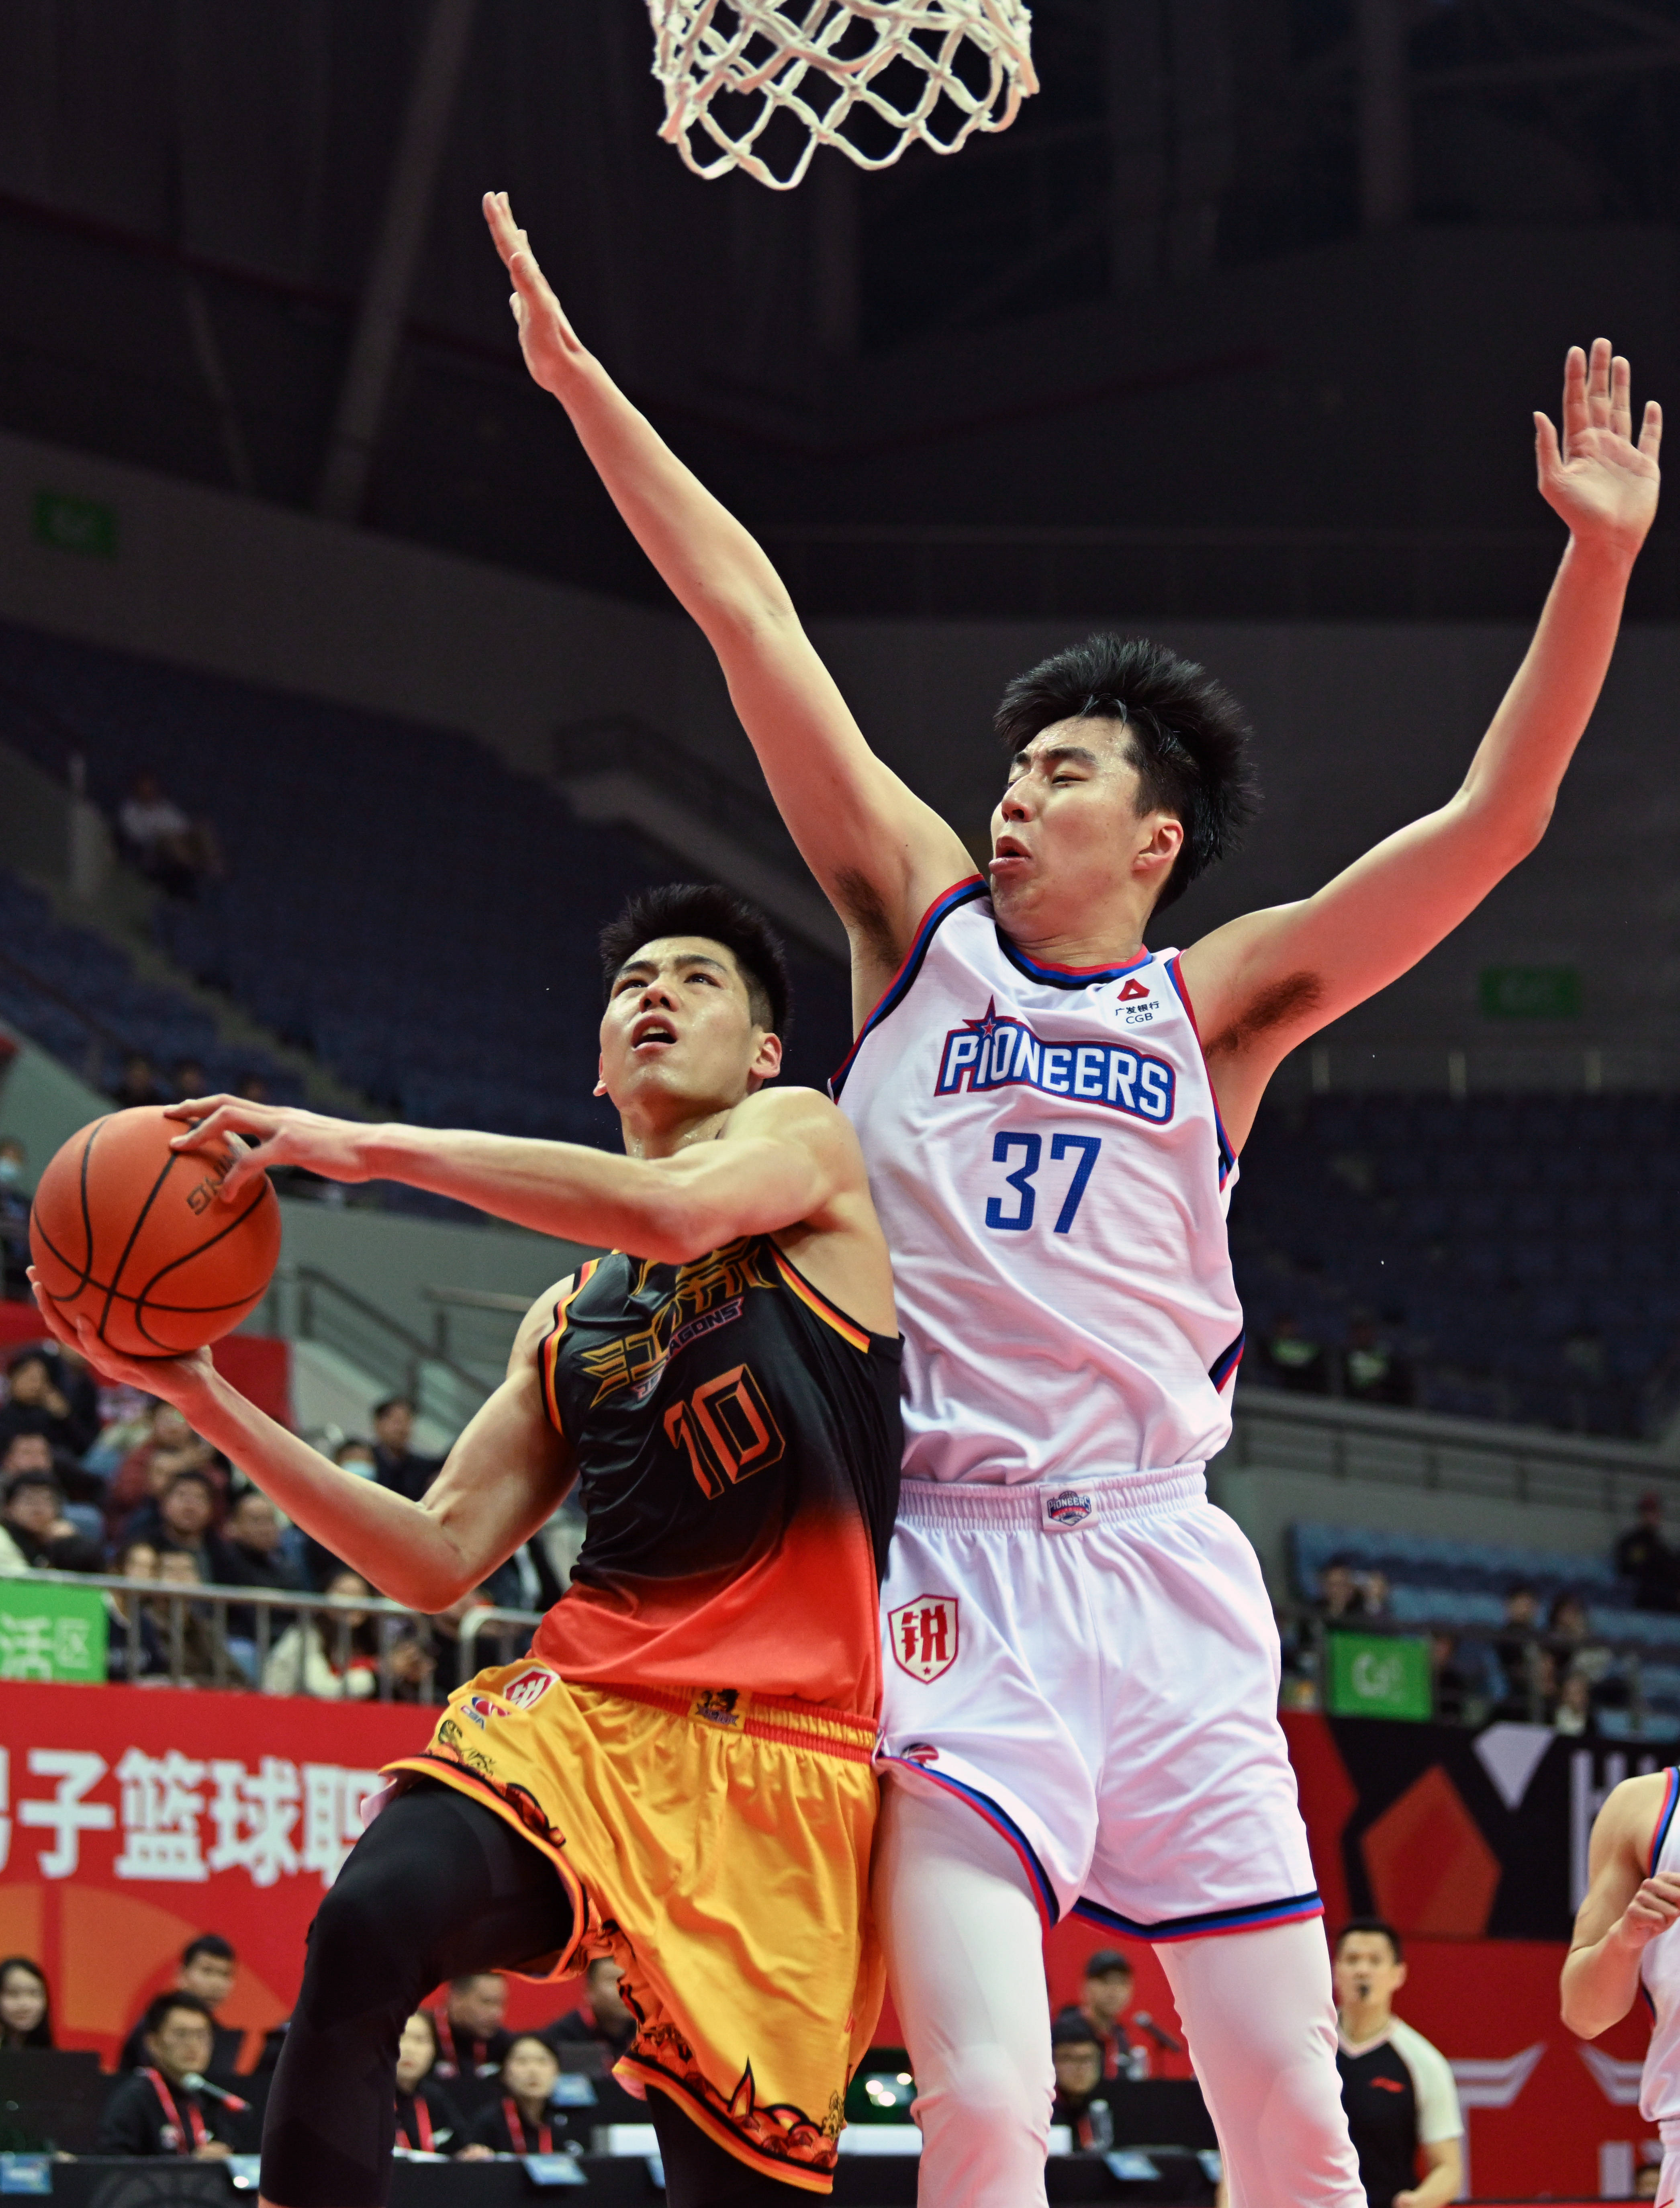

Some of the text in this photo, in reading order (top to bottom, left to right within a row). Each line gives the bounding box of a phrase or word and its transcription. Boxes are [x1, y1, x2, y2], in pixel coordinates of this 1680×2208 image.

[1116, 1001, 1160, 1016] 广发银行
[1126, 1013, 1153, 1024] CGB
[943, 1026, 1168, 1118] PIONEERS
[985, 1131, 1102, 1234] 37
[664, 1363, 785, 1500] 10
[1048, 1495, 1091, 1516] PIONEERS
[0, 1744, 386, 1889] 子篮球职
